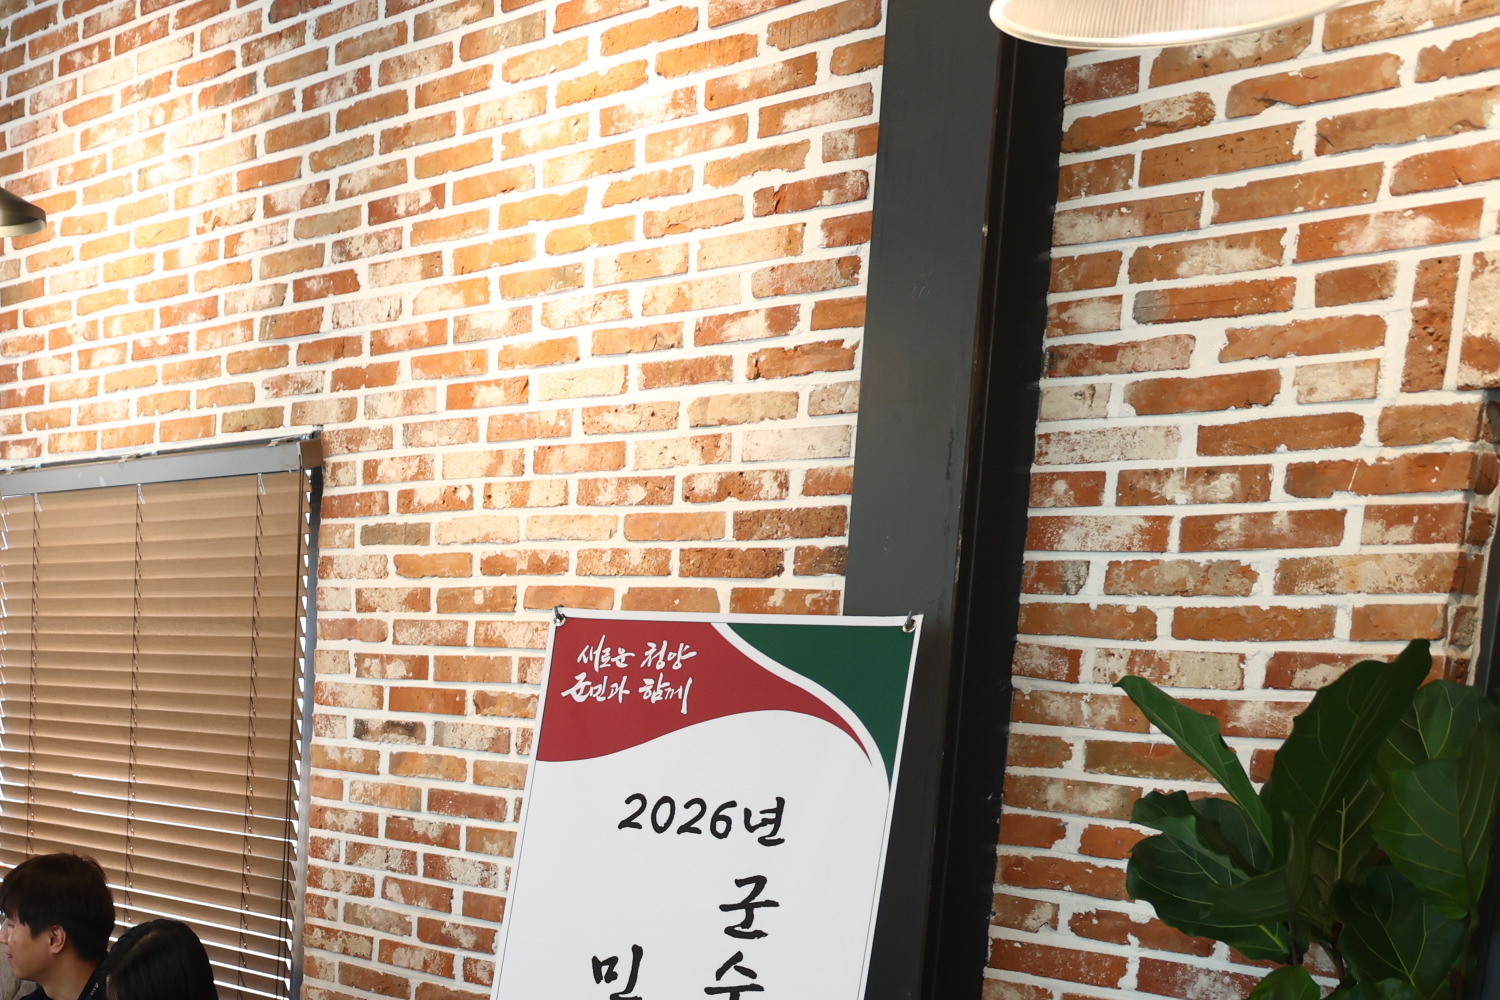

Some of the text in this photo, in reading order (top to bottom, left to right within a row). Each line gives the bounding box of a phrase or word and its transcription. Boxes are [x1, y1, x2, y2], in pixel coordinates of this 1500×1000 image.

[577, 634, 698, 673] 새로운 청양
[560, 672, 693, 715] 군민과 함께
[617, 792, 786, 847] 2026년
